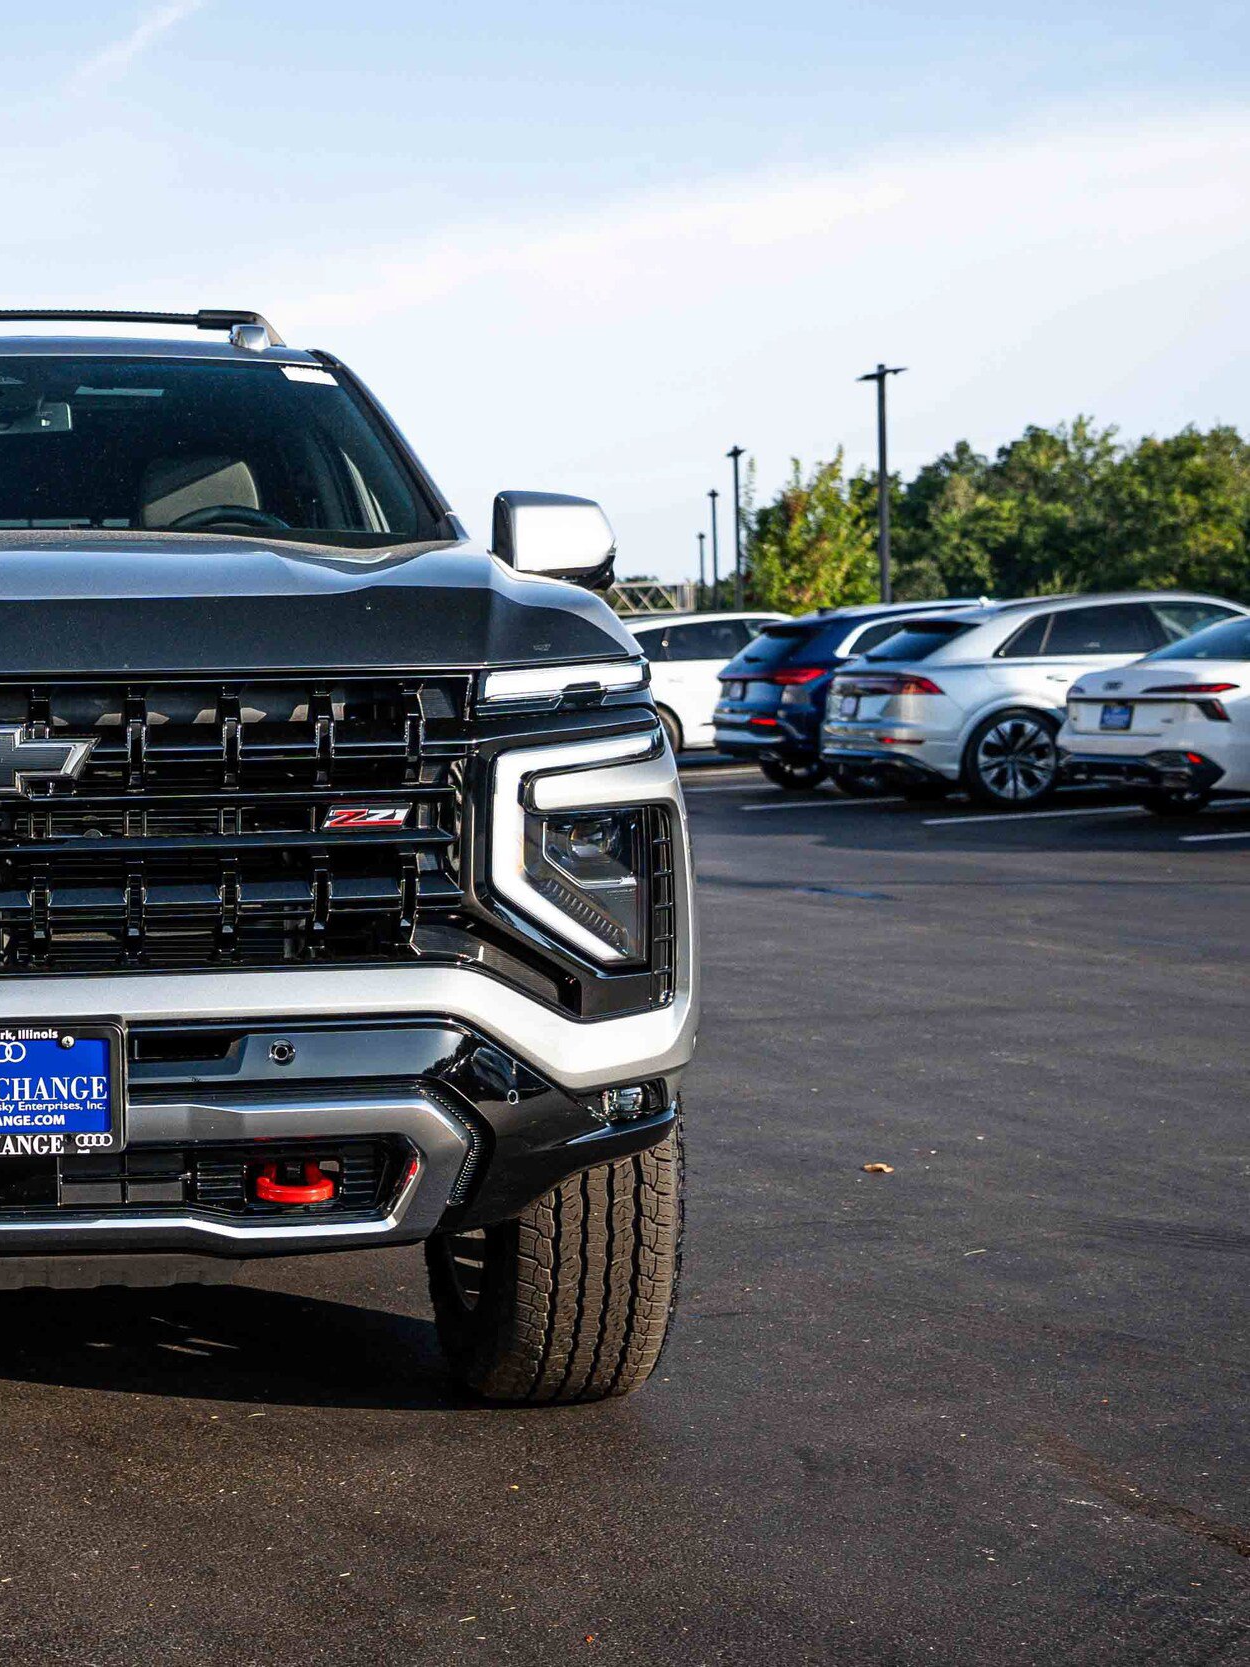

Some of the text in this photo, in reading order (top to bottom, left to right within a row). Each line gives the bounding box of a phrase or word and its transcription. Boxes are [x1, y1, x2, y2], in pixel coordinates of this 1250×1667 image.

[323, 808, 410, 828] Z71
[18, 1029, 59, 1040] Illinois
[18, 1101, 83, 1112] Enterprises,
[87, 1101, 106, 1110] Inc.
